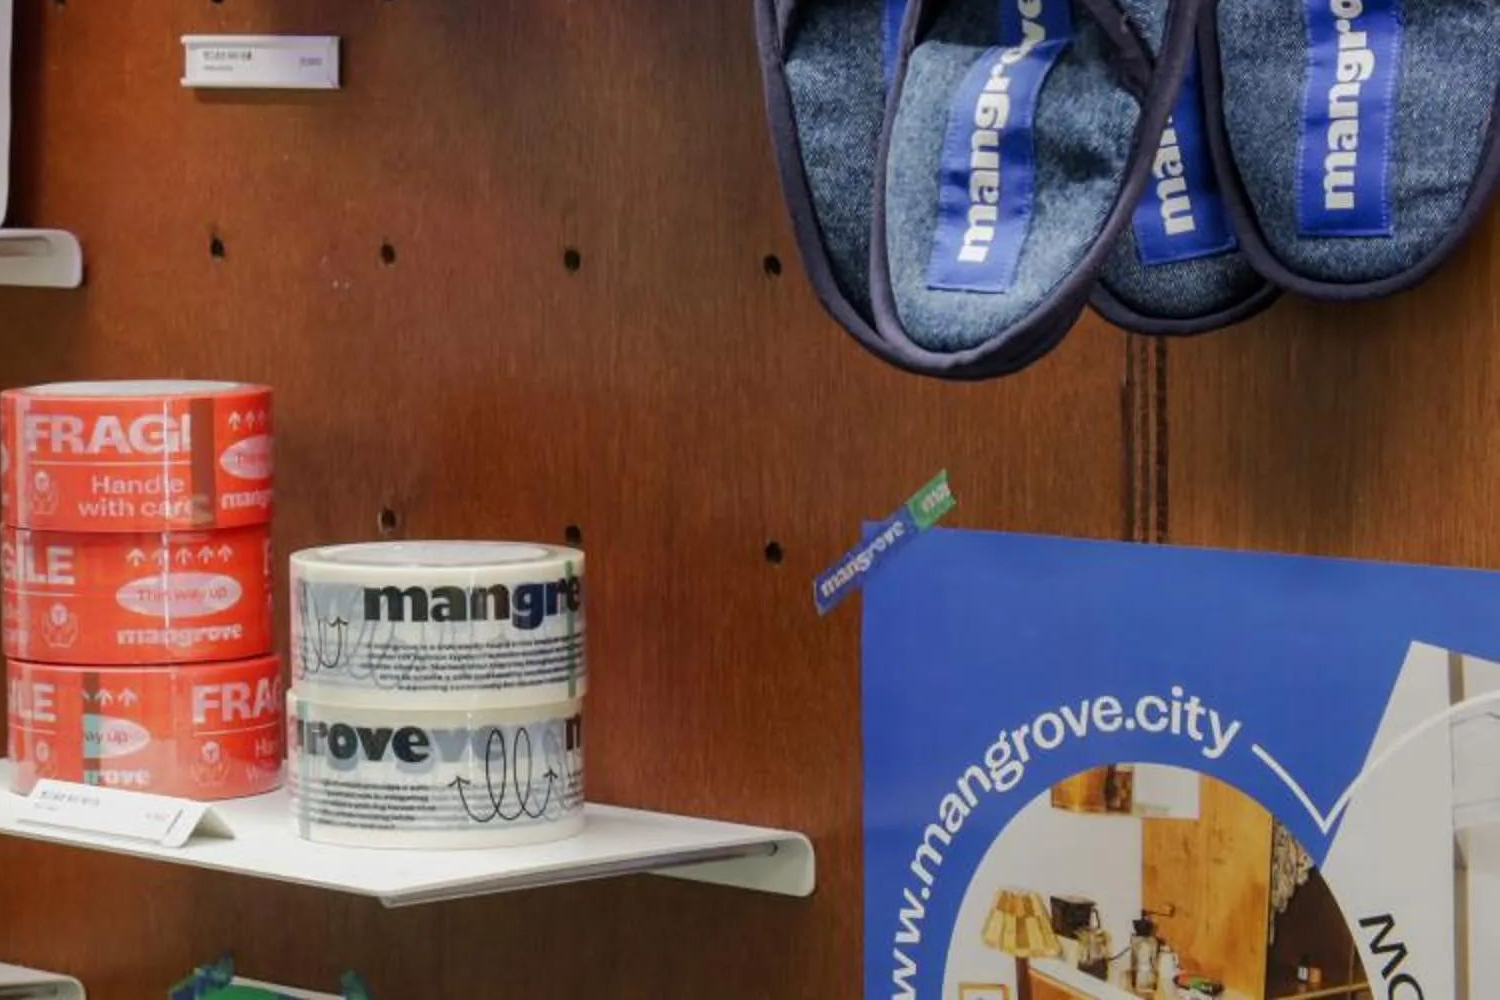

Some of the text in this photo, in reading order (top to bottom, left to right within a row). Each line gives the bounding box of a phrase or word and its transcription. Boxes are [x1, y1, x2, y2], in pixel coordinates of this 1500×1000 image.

[23, 413, 192, 455] FRAGI
[91, 474, 185, 496] Handle
[78, 497, 134, 518] with
[821, 520, 905, 598] mangrove
[117, 623, 243, 647] mangrove
